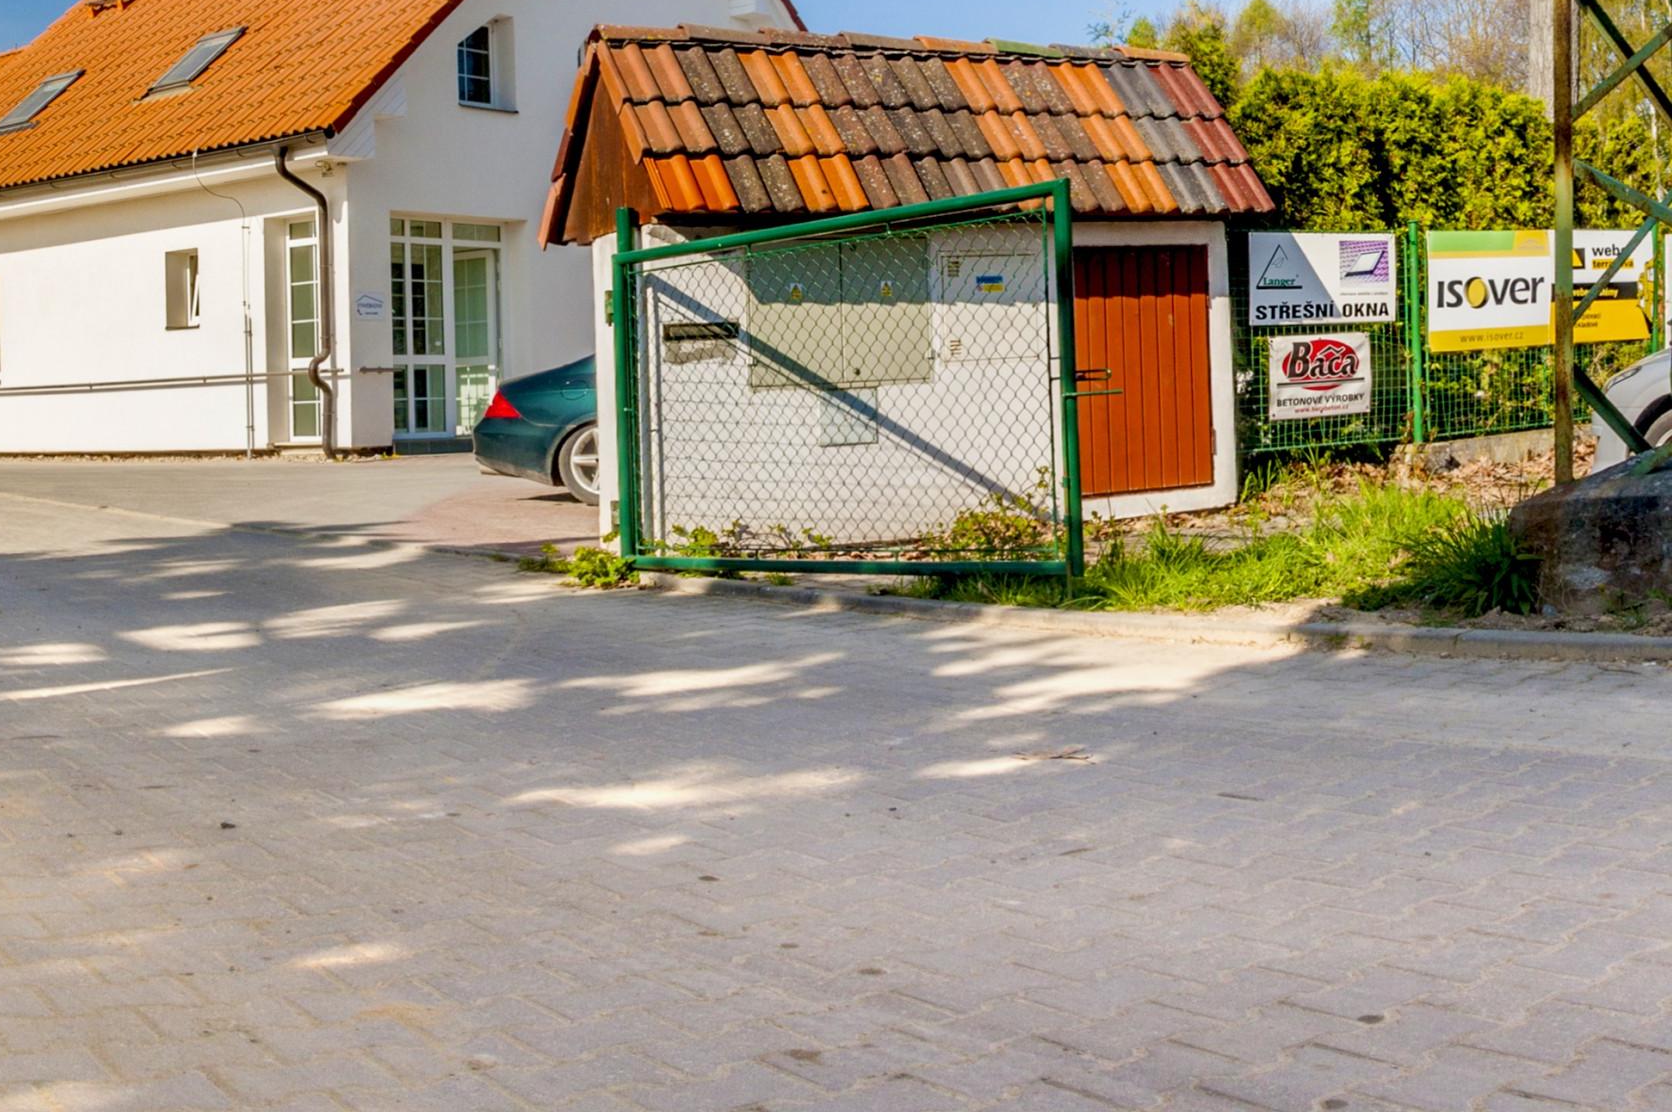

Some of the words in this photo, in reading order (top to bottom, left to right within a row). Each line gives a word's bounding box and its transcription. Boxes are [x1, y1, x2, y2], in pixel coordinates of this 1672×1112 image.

[1592, 243, 1625, 257] web
[1263, 277, 1295, 288] Langer
[1255, 300, 1334, 320] STŘEŠNÍ
[1342, 302, 1389, 318] OKNA
[1459, 331, 1525, 343] www.isover.cz
[1276, 395, 1323, 407] BETONOVÉ
[1325, 392, 1365, 404] VÝROBKY
